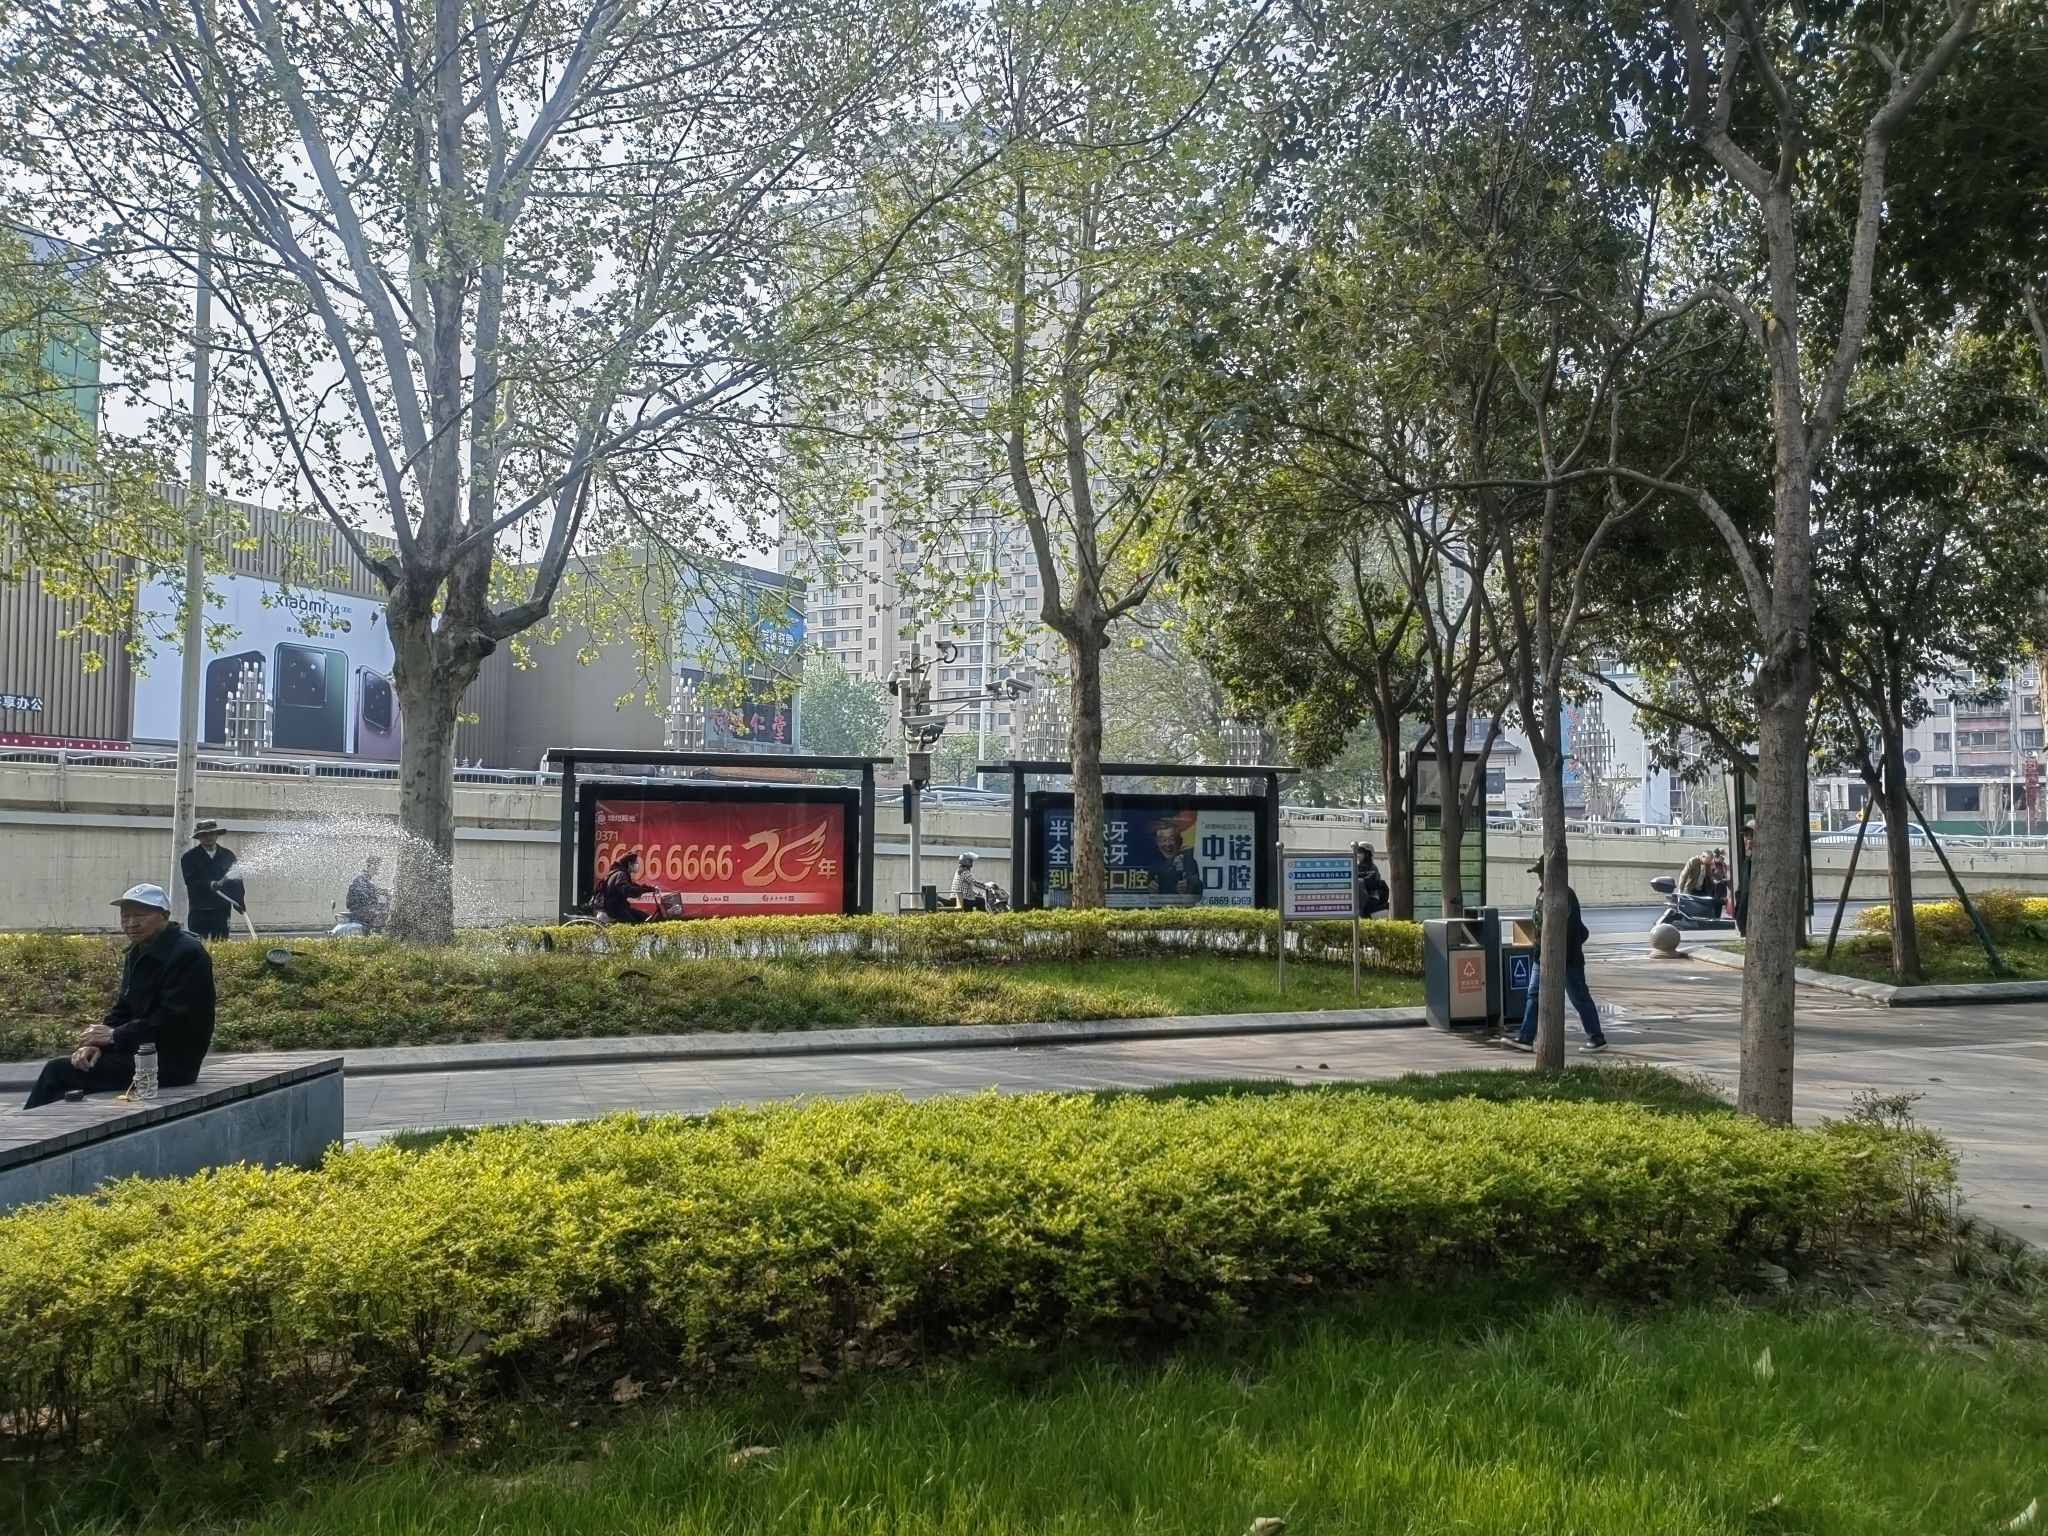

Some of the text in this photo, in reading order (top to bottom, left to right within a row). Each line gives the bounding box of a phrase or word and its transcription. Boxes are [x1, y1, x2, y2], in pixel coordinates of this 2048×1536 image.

[596, 830, 619, 841] 0371
[1049, 819, 1129, 842] 半牙
[1048, 843, 1129, 865] 全牙
[1202, 834, 1252, 861] 中诺
[1048, 868, 1149, 890] 到口腔
[1202, 864, 1252, 891] 口腔
